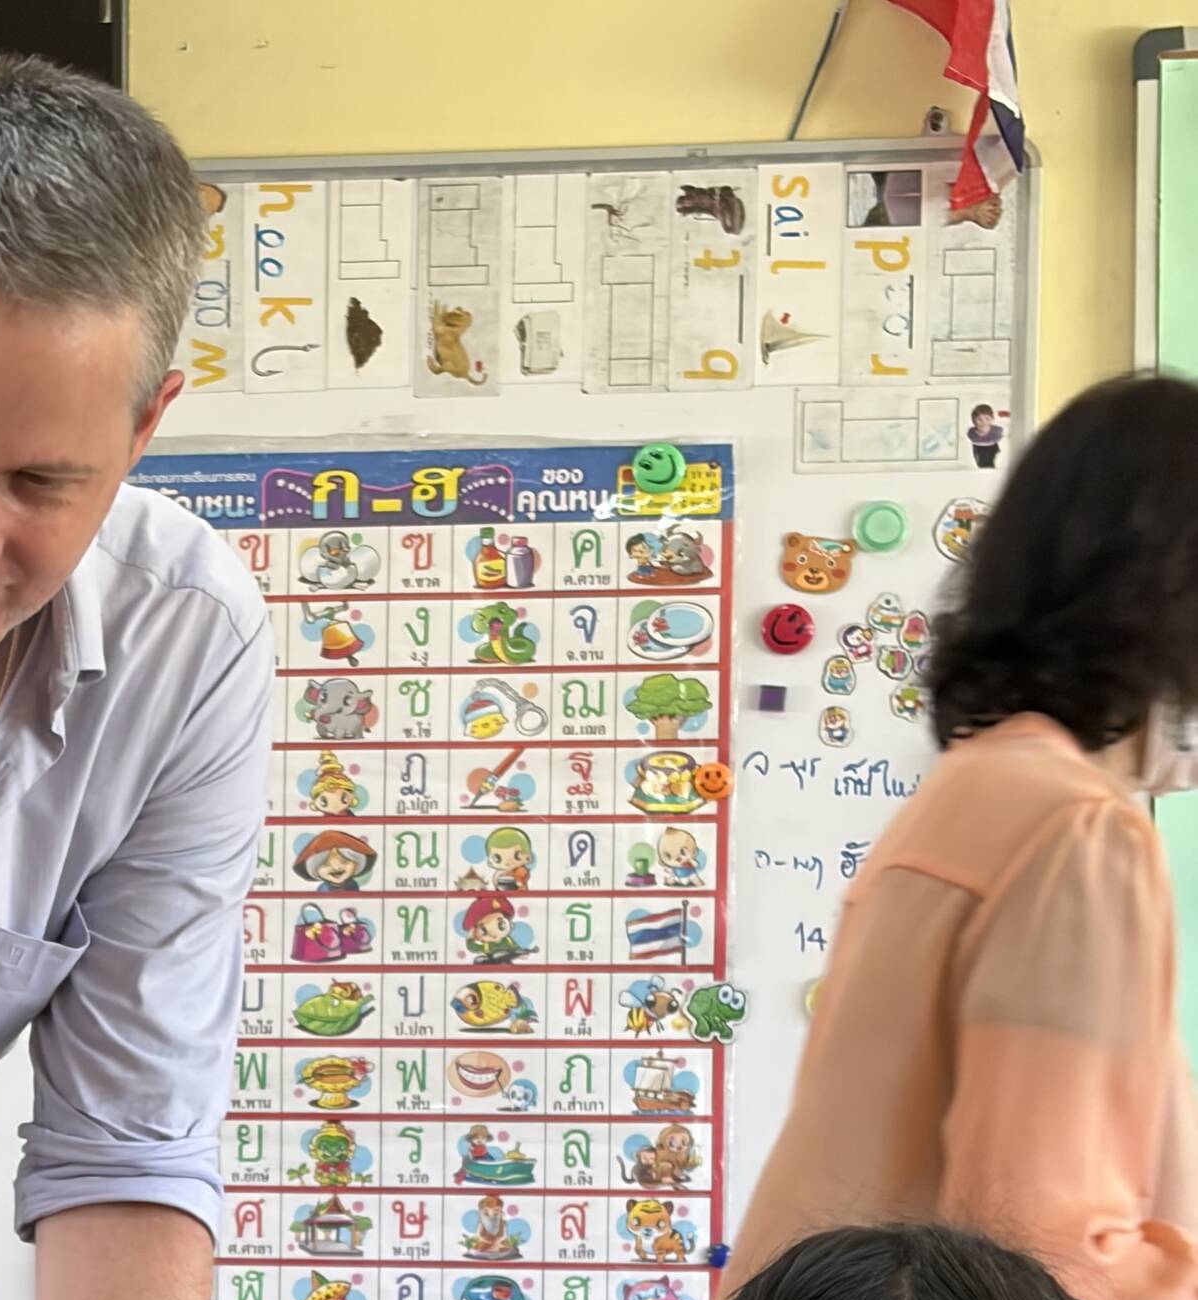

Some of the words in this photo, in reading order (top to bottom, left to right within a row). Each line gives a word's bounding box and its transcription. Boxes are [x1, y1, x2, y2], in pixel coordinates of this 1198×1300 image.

[771, 174, 827, 275] sail
[256, 184, 313, 327] hook
[541, 467, 584, 486] ของ
[239, 533, 270, 572] ข
[571, 529, 602, 569] ค
[404, 607, 430, 647] ง
[569, 605, 599, 643] จ
[399, 679, 433, 717] ซ
[562, 679, 605, 718] ฌ
[566, 751, 594, 796] ฐ
[395, 831, 440, 869] ณ
[568, 830, 596, 867] ด
[397, 905, 430, 943] ท
[565, 903, 592, 942] ธ
[794, 921, 827, 953] 14
[398, 976, 425, 1017] ป
[564, 978, 593, 1016] ผ
[234, 1052, 268, 1090] พ
[396, 1050, 427, 1093] ฟ
[559, 1054, 592, 1094] ภ
[237, 1124, 264, 1163] ย
[397, 1126, 424, 1164] ร
[563, 1129, 591, 1168] ล
[234, 1199, 265, 1238] ศ
[391, 1200, 429, 1239] ษ
[559, 1202, 589, 1241] ส
